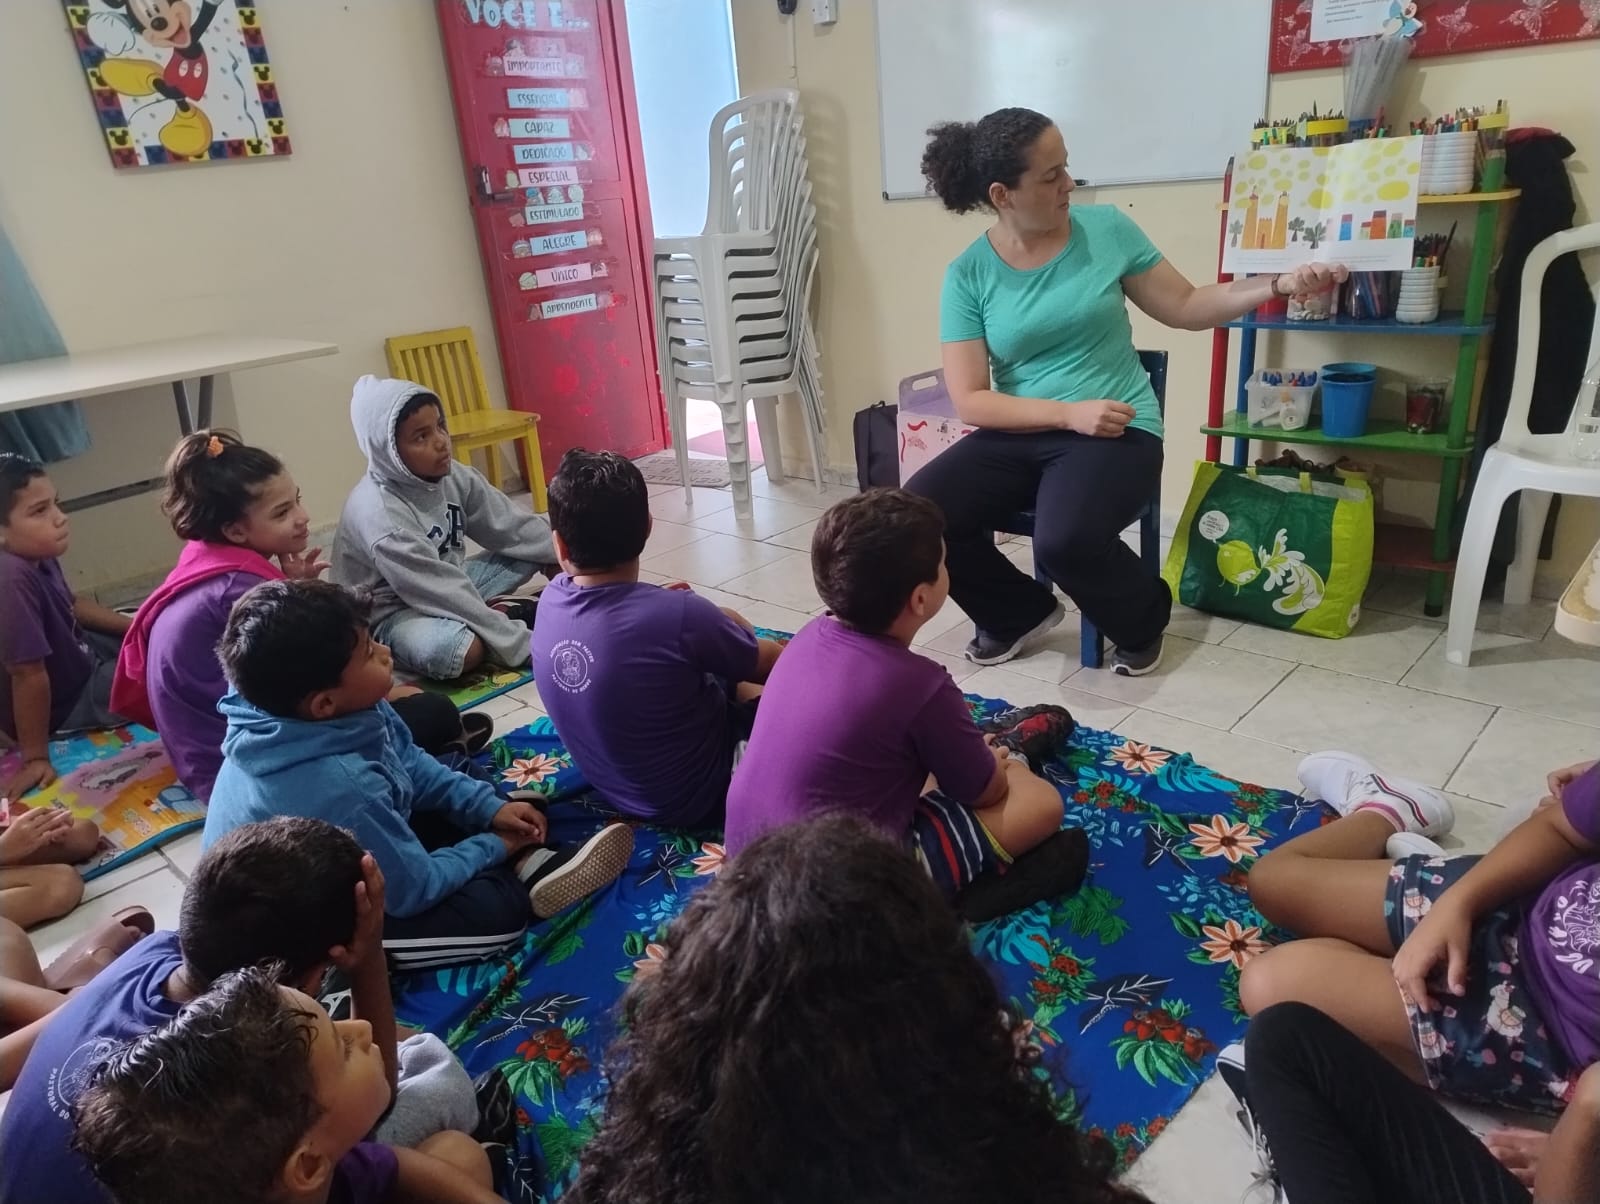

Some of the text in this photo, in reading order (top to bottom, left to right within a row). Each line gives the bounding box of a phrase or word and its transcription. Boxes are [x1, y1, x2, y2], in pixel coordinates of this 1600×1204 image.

[507, 60, 562, 72] IMPORTANTE
[517, 93, 559, 105] ESSENCIAL
[524, 121, 554, 133] CAPAZ
[521, 147, 567, 159] DEDICADO
[528, 170, 571, 184] ESPECIAL
[530, 208, 580, 221] ESTIMULADO
[542, 234, 577, 250] ALEGRE
[546, 298, 593, 314] APRENDENTE
[47, 1067, 59, 1112] PASTORAL
